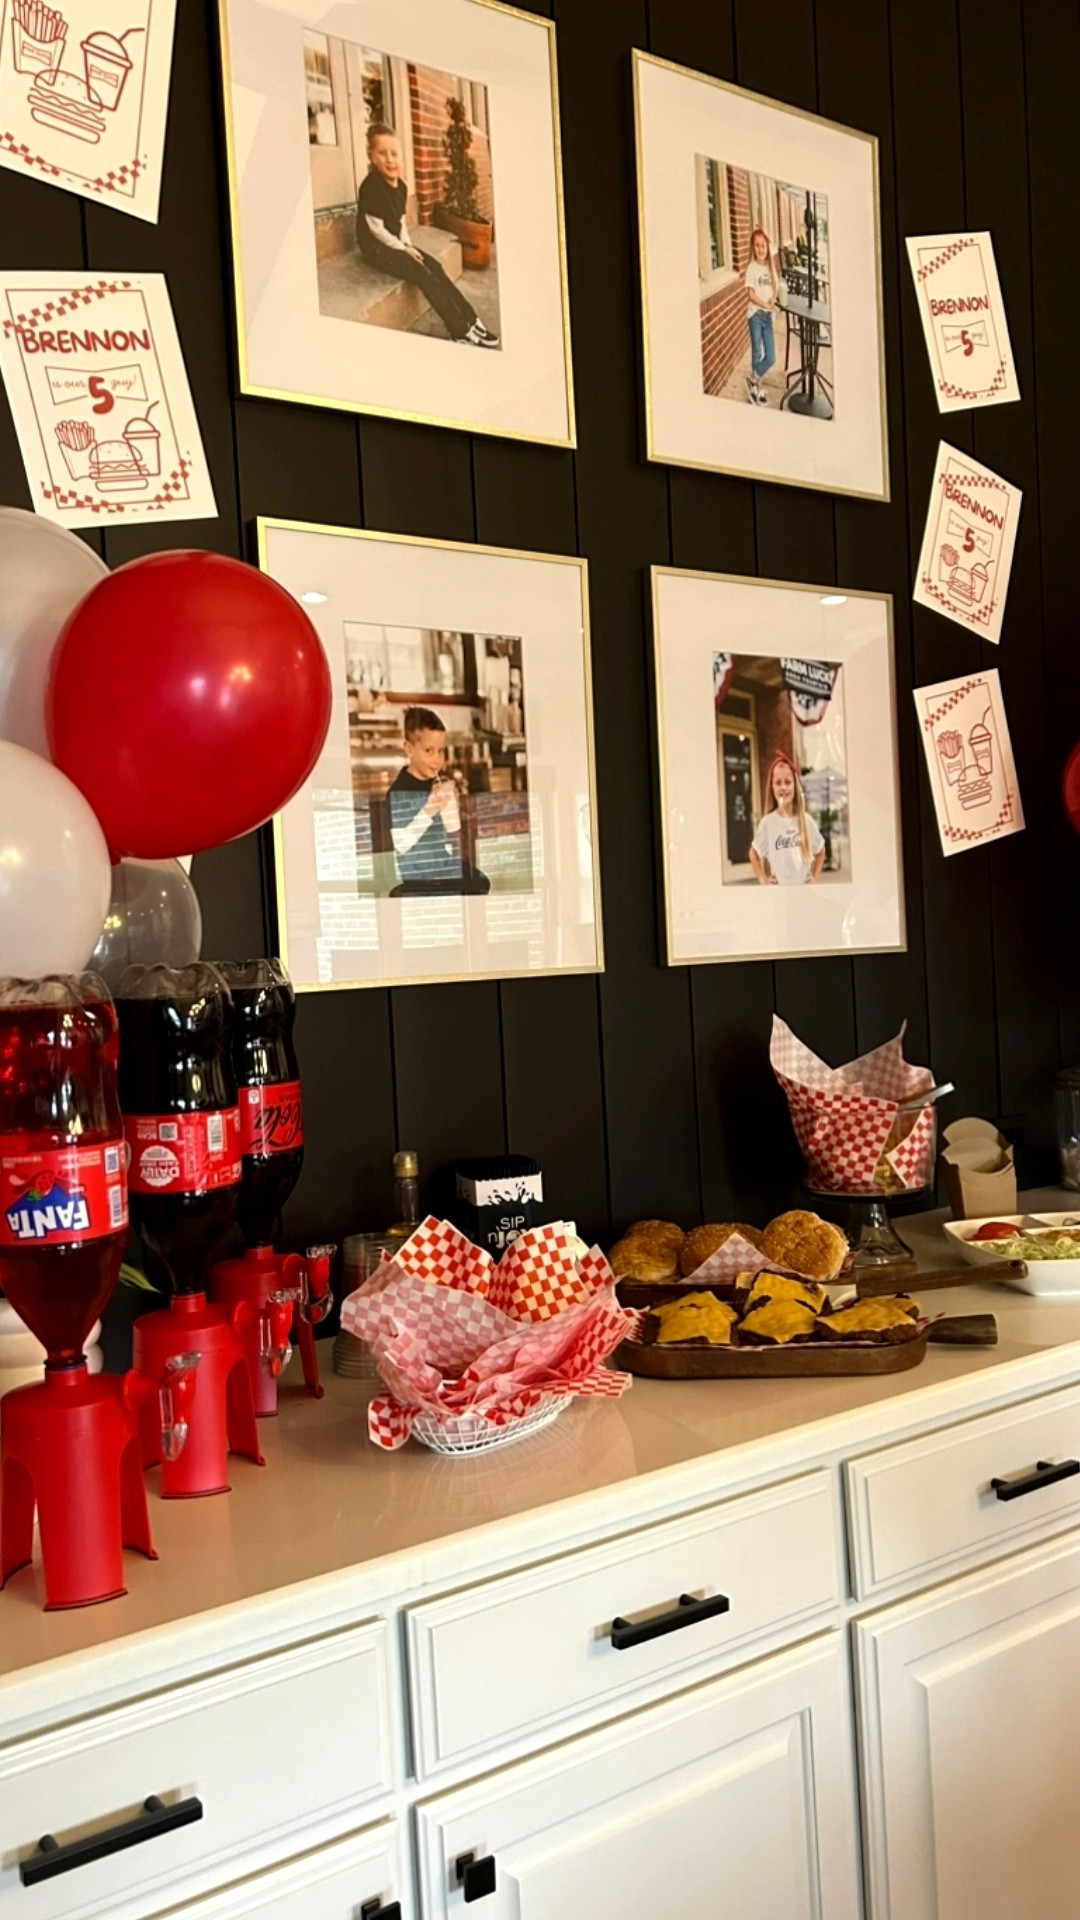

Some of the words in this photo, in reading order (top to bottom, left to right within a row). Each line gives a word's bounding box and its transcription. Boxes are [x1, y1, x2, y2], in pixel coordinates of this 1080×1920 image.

[929, 295, 989, 317] BRENNON
[22, 328, 151, 354] BRENNON
[960, 329, 975, 357] 5
[88, 375, 115, 415] 5
[944, 482, 1004, 530] BRENNON
[962, 527, 976, 553] 5
[139, 1166, 180, 1179] DAILY
[6, 1199, 91, 1239] FANTA
[499, 1215, 526, 1230] SIP
